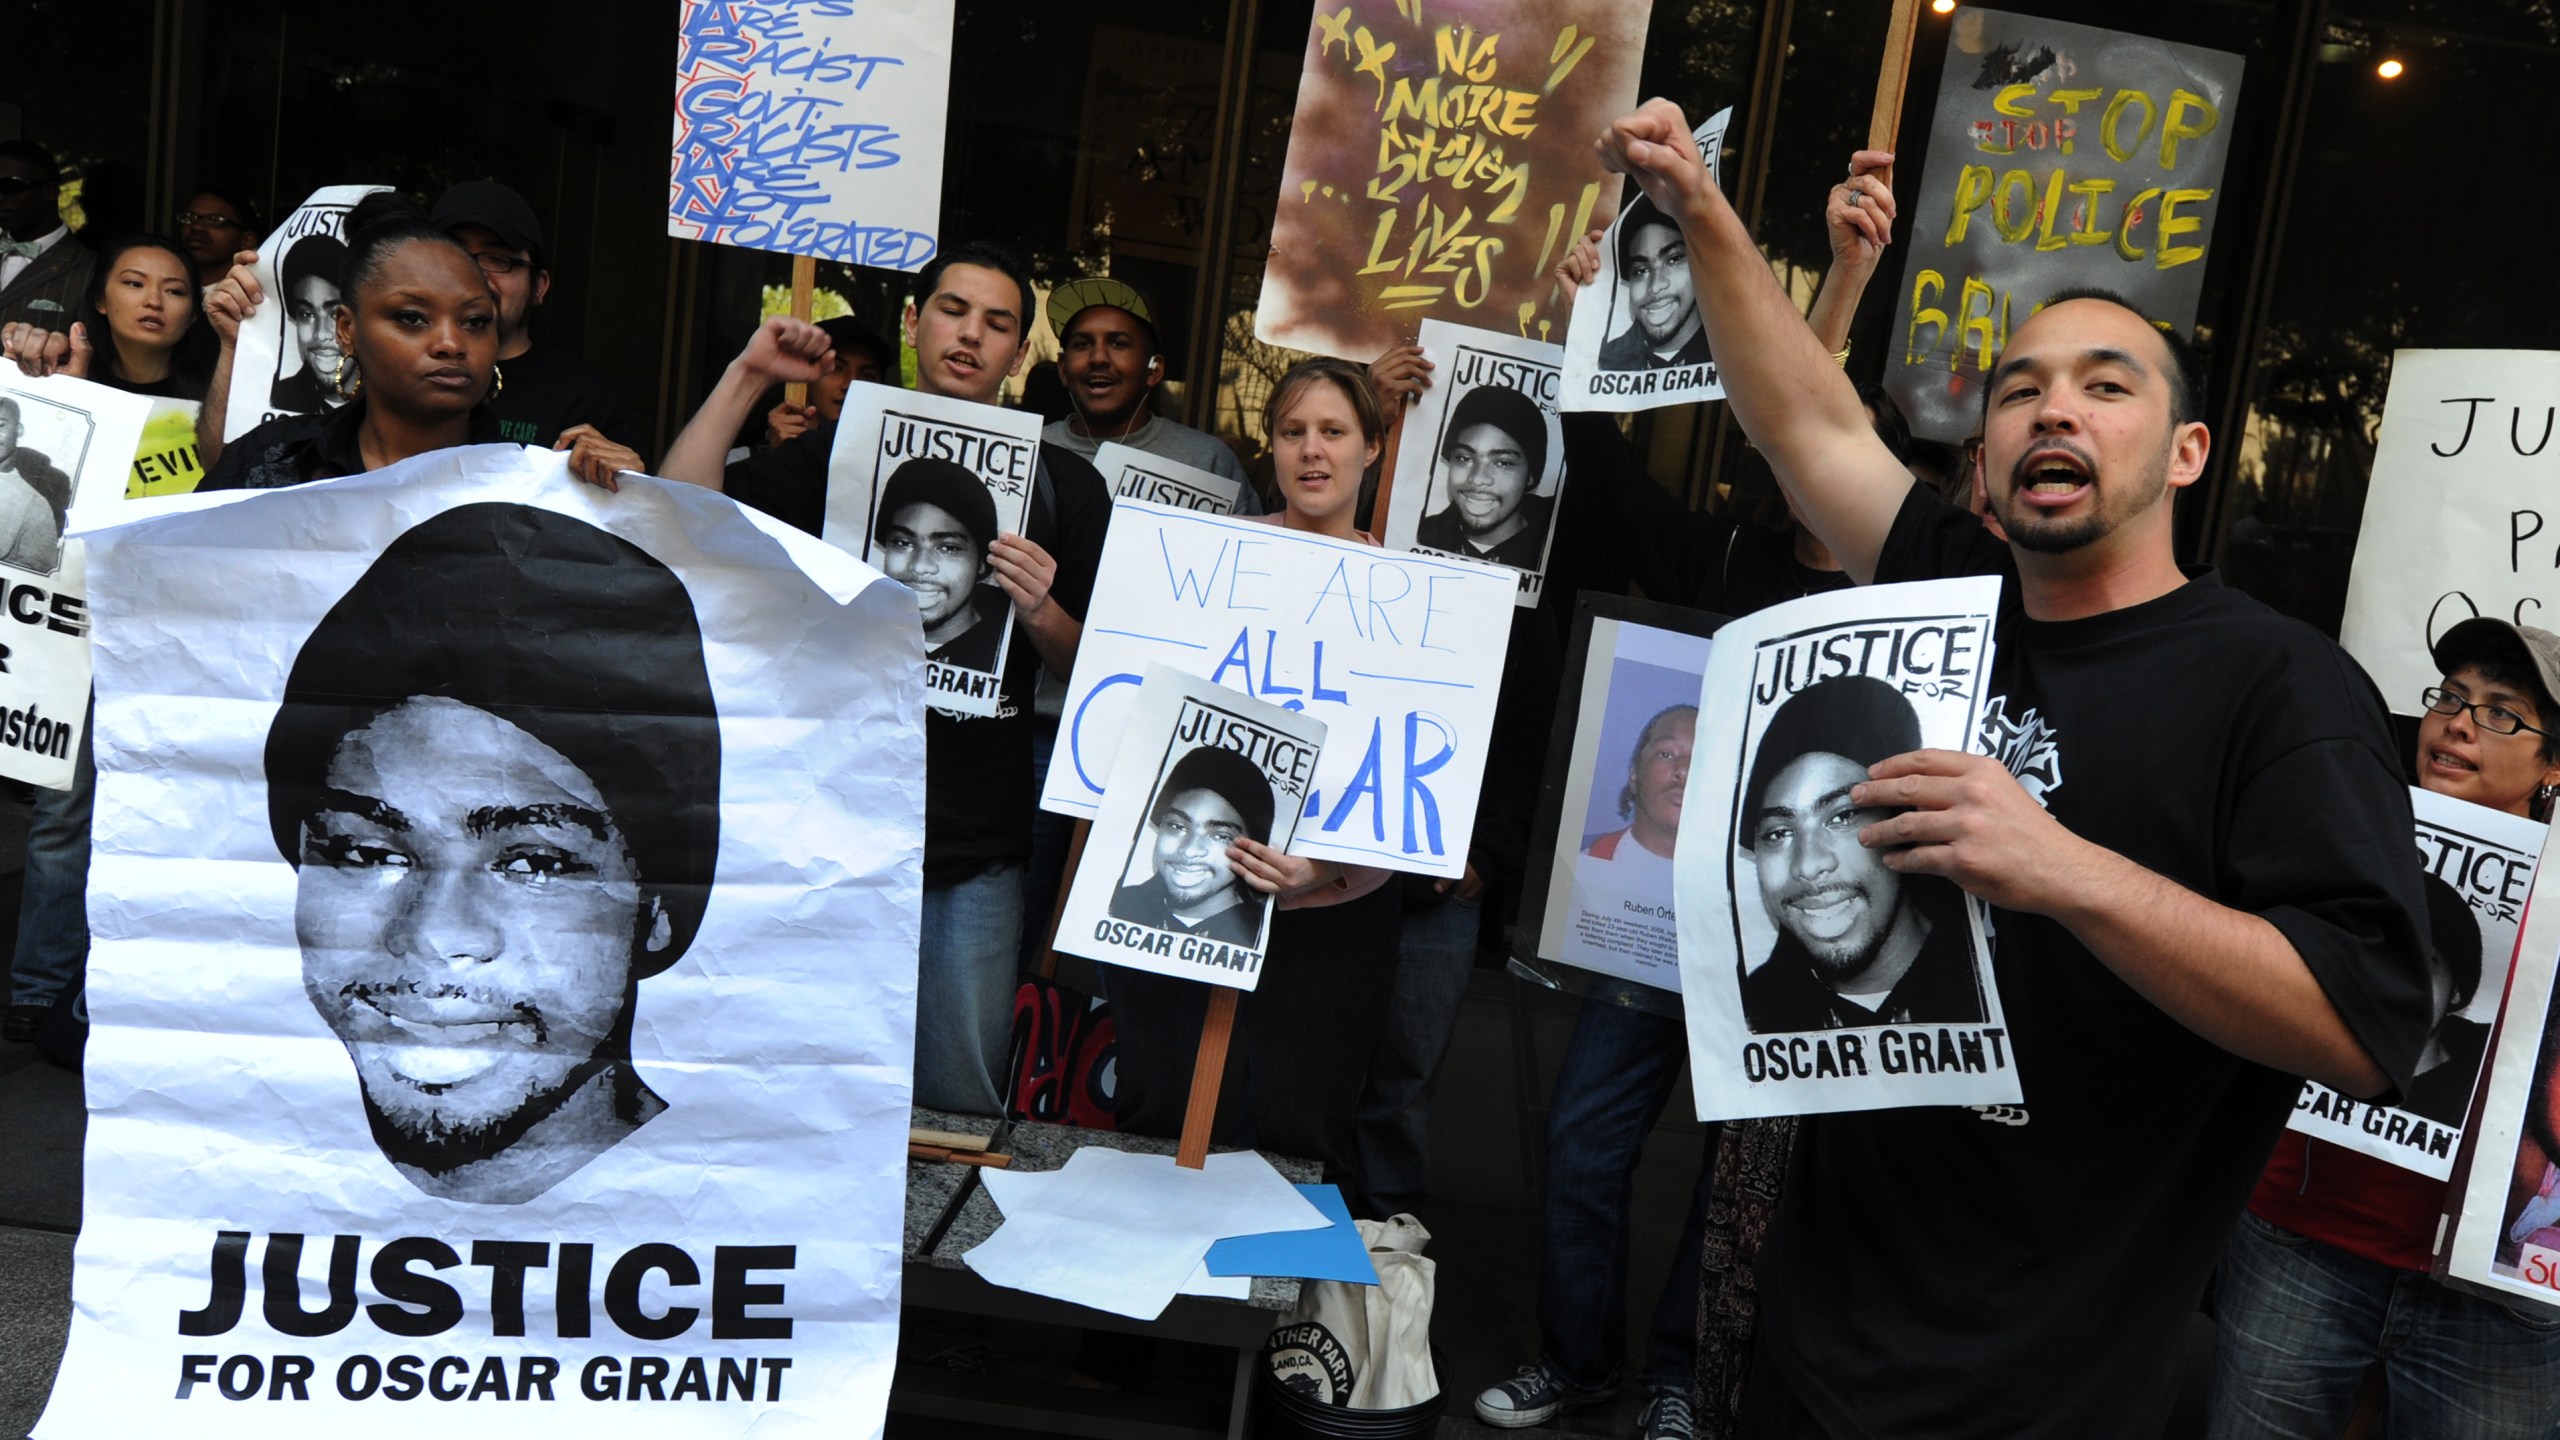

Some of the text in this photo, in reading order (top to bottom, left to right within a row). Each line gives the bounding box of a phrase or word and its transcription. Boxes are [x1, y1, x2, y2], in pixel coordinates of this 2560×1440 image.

[682, 0, 803, 39] ARE
[1435, 25, 1500, 82] NO
[1381, 78, 1541, 139] MORE
[674, 148, 821, 192] ARE
[671, 182, 832, 222] NOT
[1945, 165, 2214, 270] POLICE
[1589, 373, 1657, 396] OSCAR
[884, 421, 1029, 482] JUSTICE
[986, 478, 1024, 499] FOR
[1159, 527, 1466, 654] WE ARE
[926, 663, 1000, 699] GRANT
[1211, 626, 1352, 706] ALL
[1756, 626, 1977, 706] JUSTICE
[1902, 680, 1971, 700] FOR
[1179, 708, 1314, 783] JUSTICE
[1268, 776, 1302, 800] FOR
[1624, 900, 1654, 916] Ruben
[2468, 893, 2518, 925] FOR
[1093, 920, 1263, 973] OSCAR GRANT
[1743, 1029, 2006, 1083] OSCAR GRANT
[2362, 1105, 2460, 1160] GRAN
[178, 1230, 797, 1340] JUSTICE
[175, 1354, 793, 1402] FOR OSCAR GRANT
[1318, 1338, 1349, 1394] PARTY
